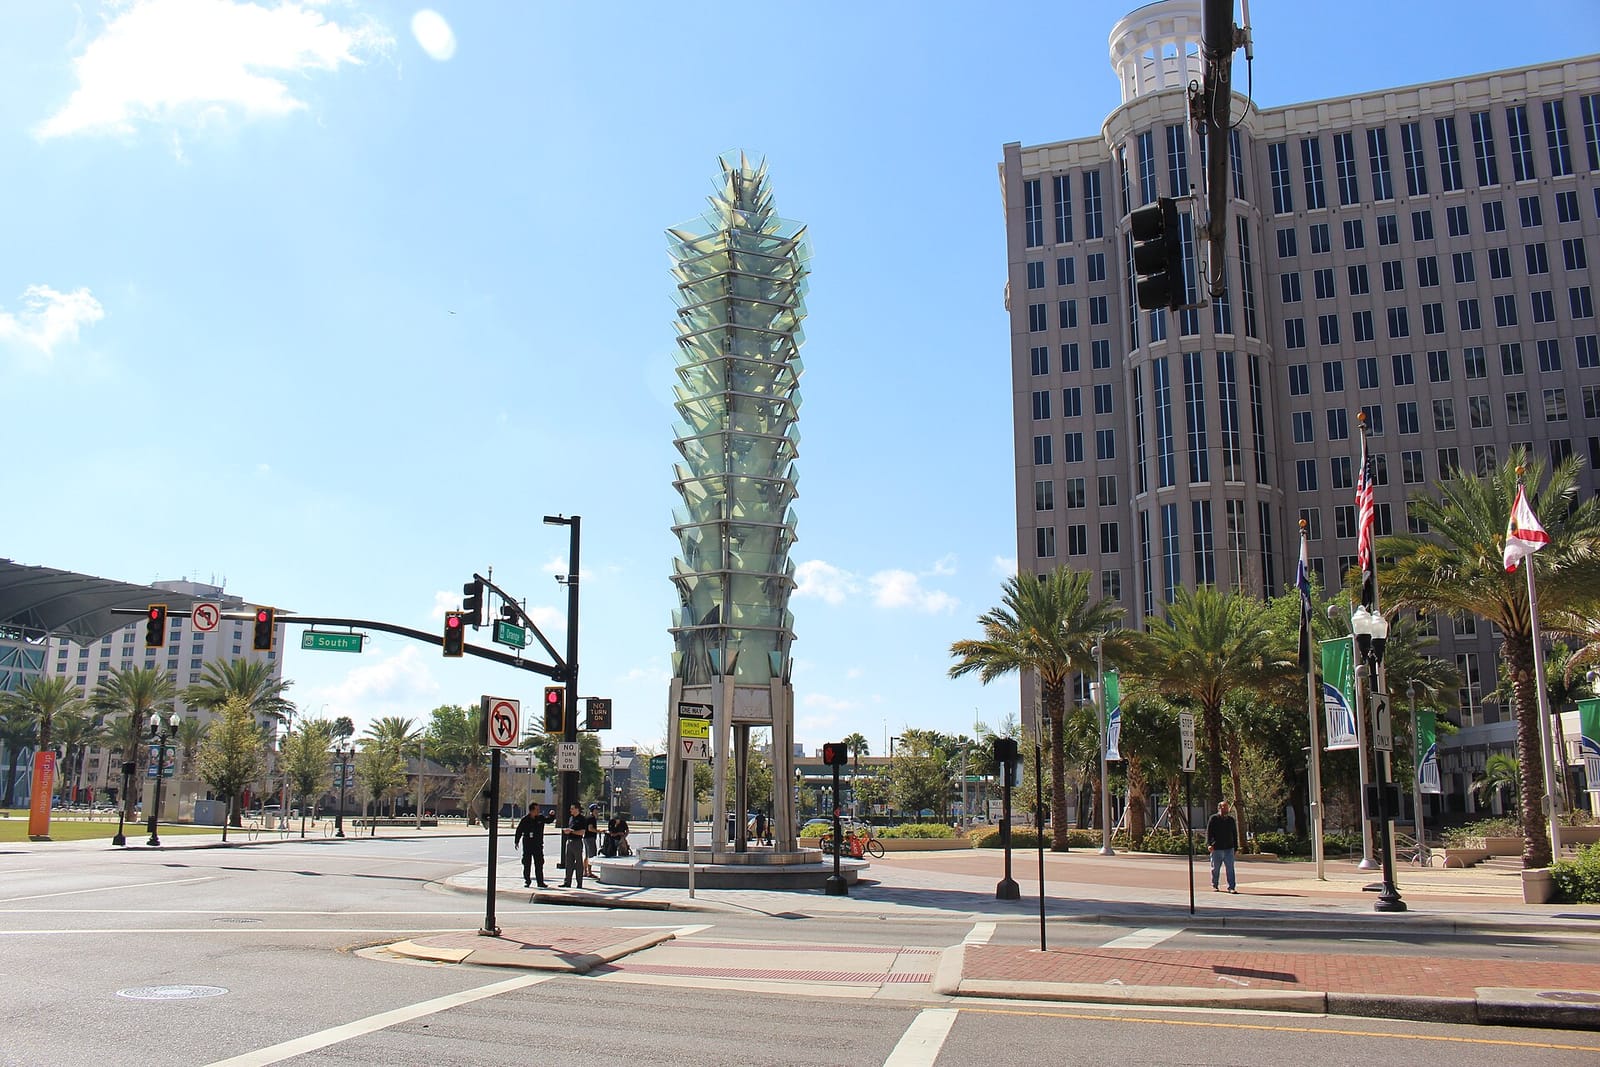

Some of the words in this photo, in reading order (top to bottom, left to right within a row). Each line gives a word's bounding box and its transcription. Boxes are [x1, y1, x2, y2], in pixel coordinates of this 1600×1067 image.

[319, 637, 348, 647] South
[1182, 718, 1193, 728] STOP
[1183, 740, 1194, 750] RED
[1377, 735, 1390, 746] ONLY
[40, 790, 48, 814] center
